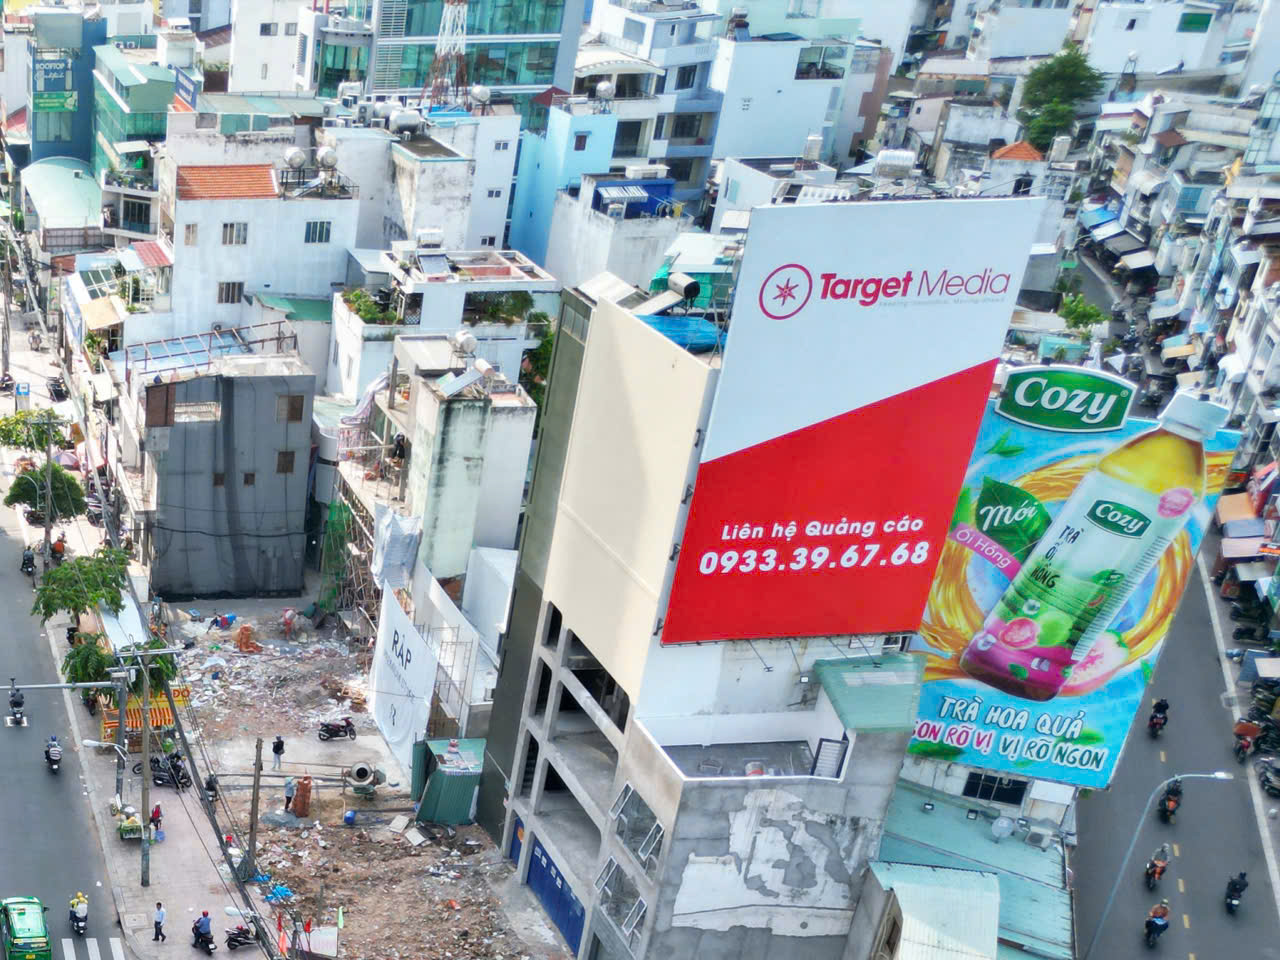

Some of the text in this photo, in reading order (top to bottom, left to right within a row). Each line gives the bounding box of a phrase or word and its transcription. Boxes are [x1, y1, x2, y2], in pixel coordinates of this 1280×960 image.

[820, 267, 1011, 307] Target Media
[1014, 376, 1118, 425] Cozy
[722, 515, 924, 541] Liên hệ Quảng cáo
[1095, 502, 1146, 534] Cozy
[699, 541, 931, 575] 0933.39.67.68
[939, 696, 984, 722] TRÀ
[985, 706, 1030, 731] HOA
[946, 725, 973, 746] RÕ
[975, 732, 994, 754] VỊ
[1001, 735, 1020, 760] VỊ
[1024, 738, 1054, 761] RÕ
[1054, 743, 1106, 769] NGON
